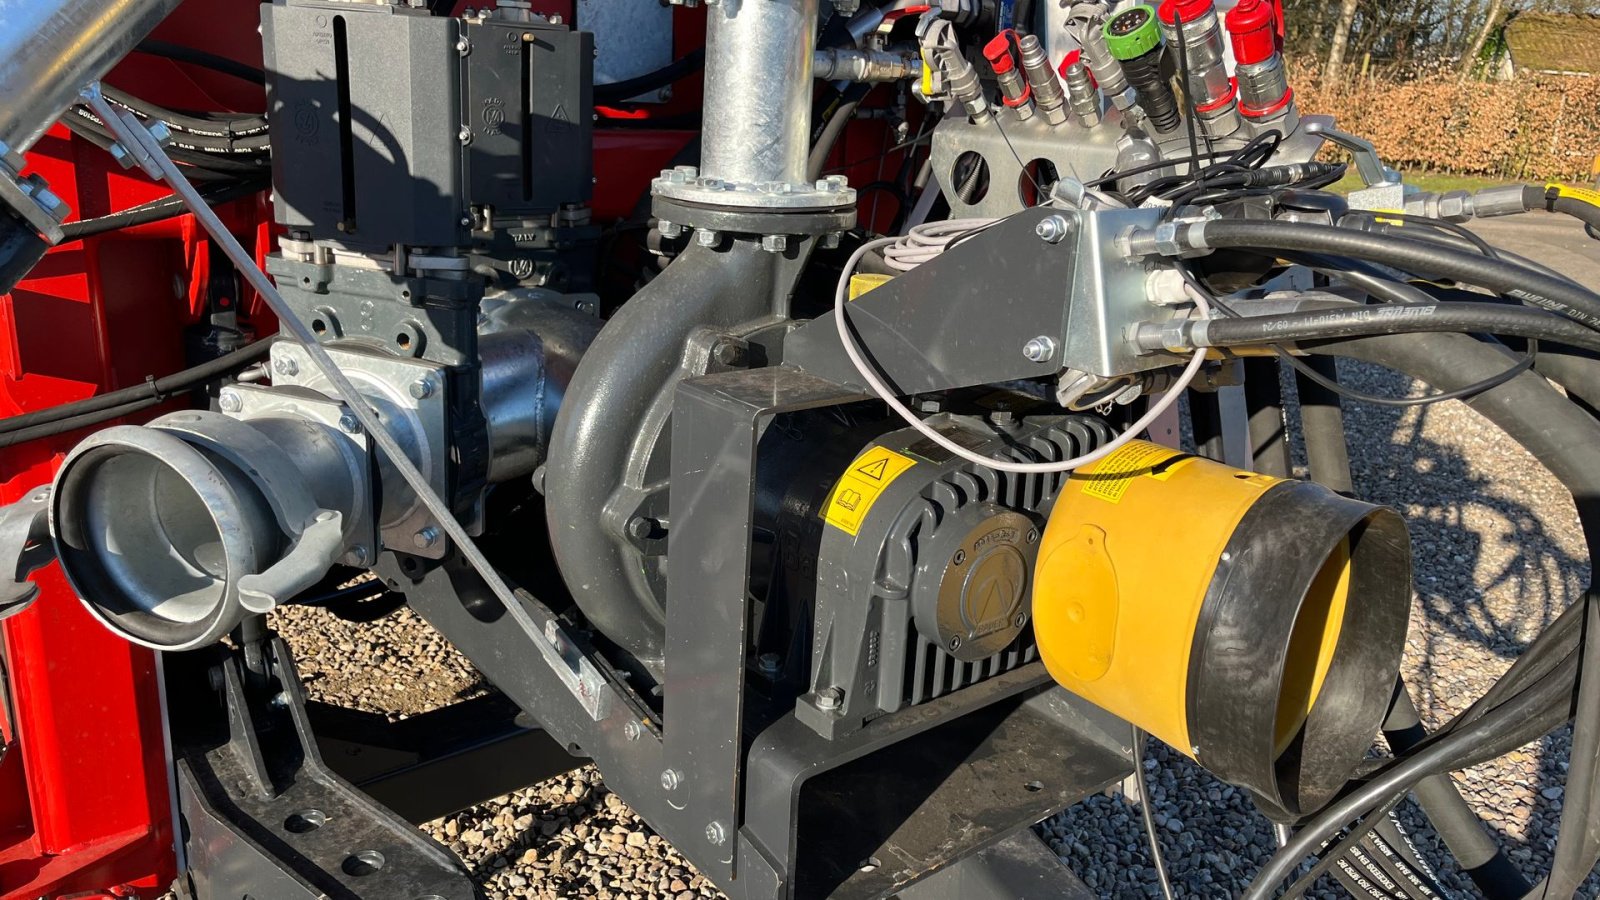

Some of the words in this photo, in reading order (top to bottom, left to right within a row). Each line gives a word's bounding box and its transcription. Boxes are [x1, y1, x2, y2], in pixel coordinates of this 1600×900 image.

[1351, 310, 1369, 321] DIN
[1373, 837, 1393, 856] MSHA
[1357, 854, 1370, 864] EN
[1394, 860, 1411, 875] BAR
[1366, 862, 1395, 889] EXCEEDS
[1418, 885, 1432, 894] WP
